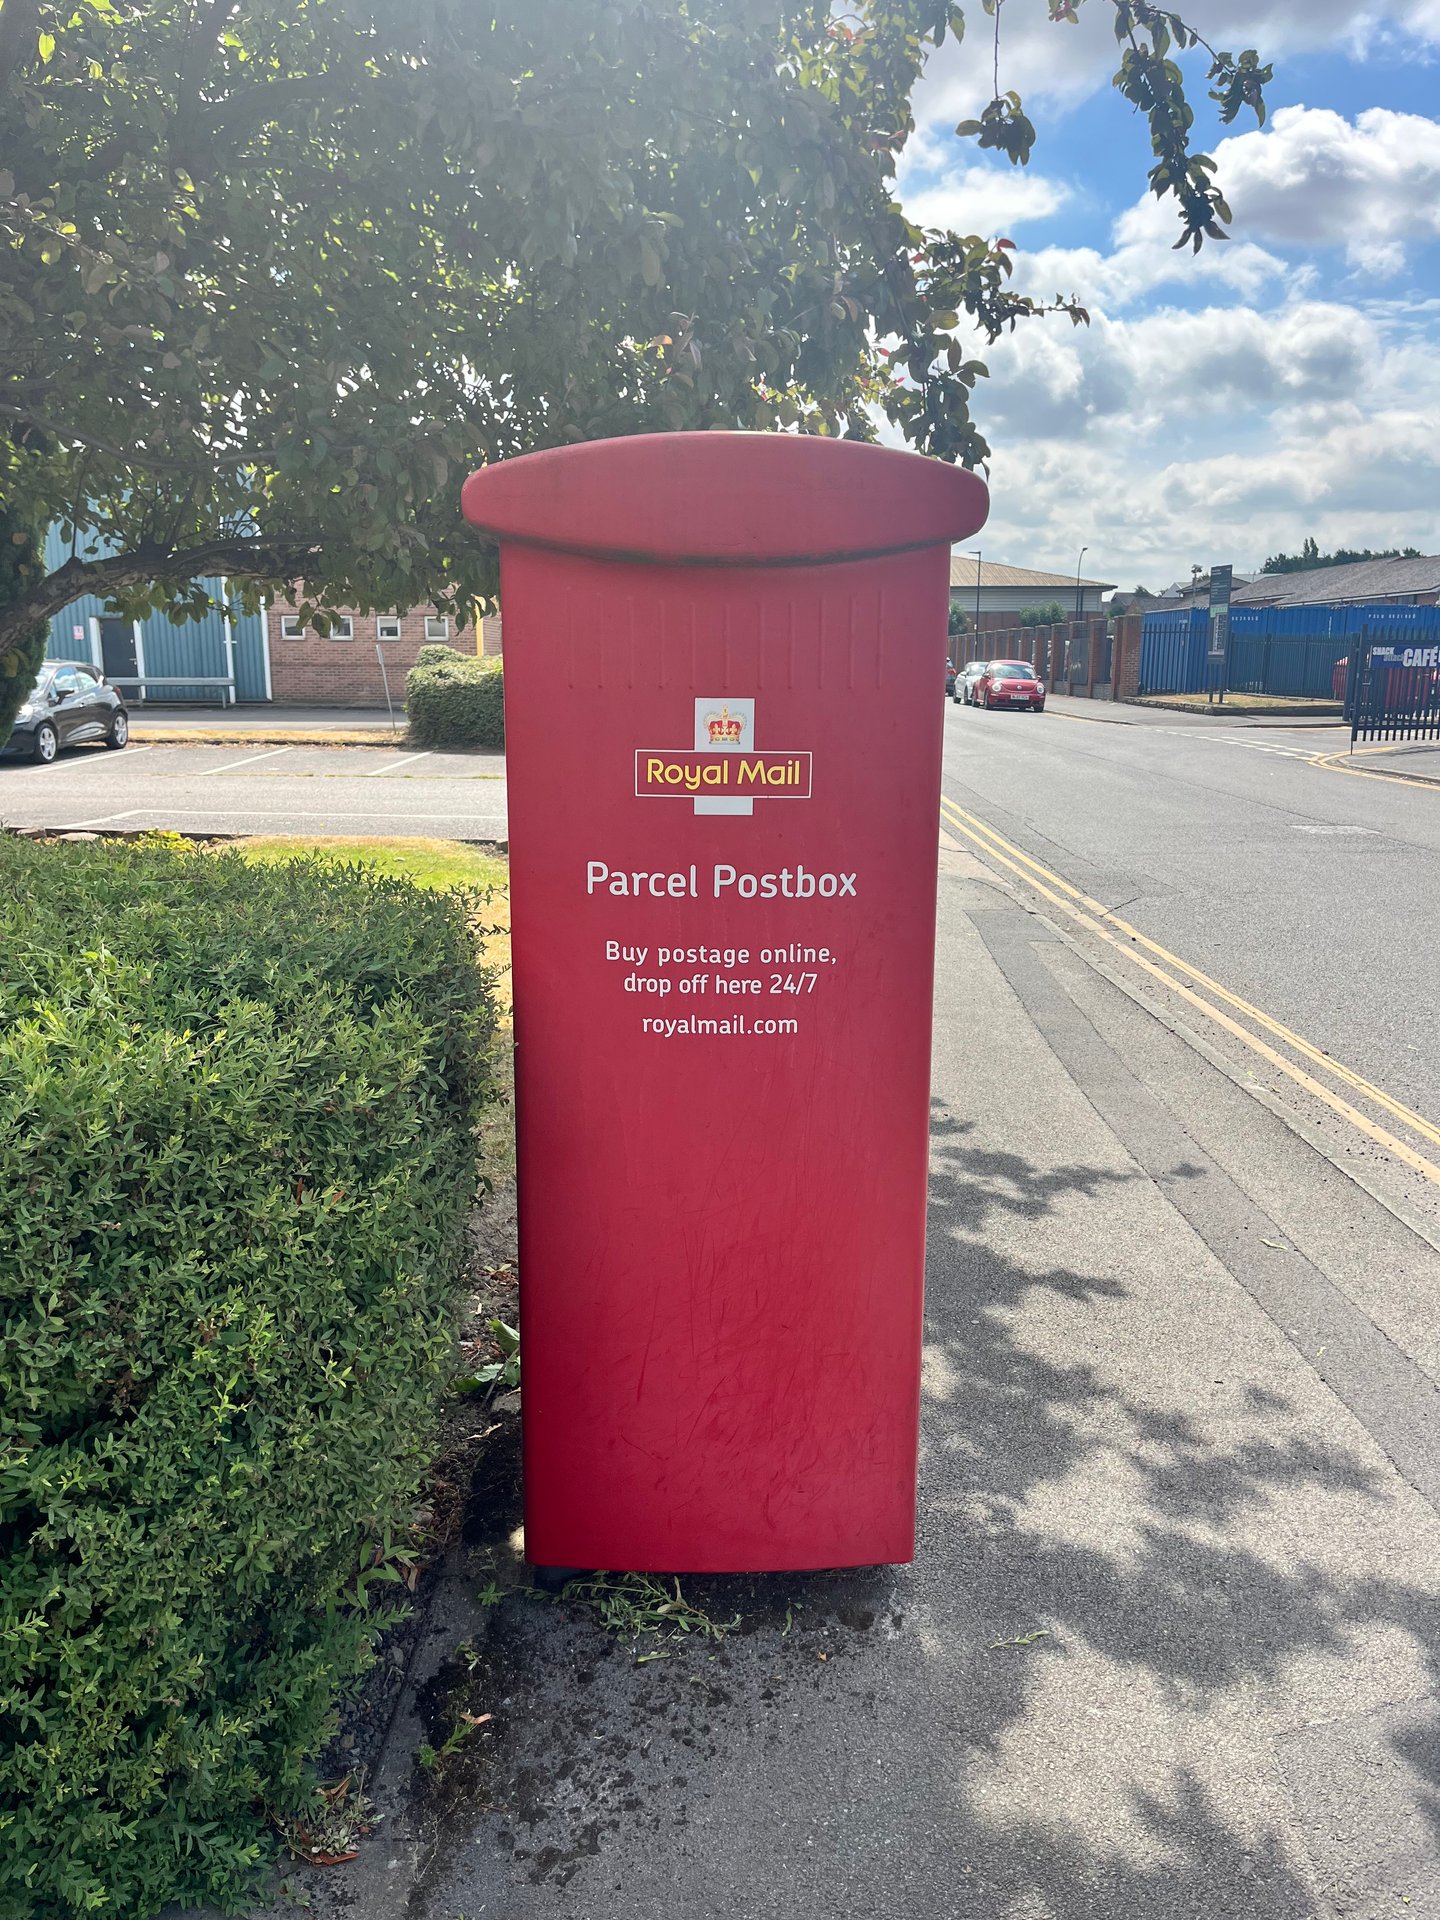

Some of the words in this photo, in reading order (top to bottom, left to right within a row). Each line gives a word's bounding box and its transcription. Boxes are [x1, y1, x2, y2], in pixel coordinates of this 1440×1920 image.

[646, 759, 729, 790] Royal
[737, 760, 801, 786] Mail
[586, 861, 699, 898] Parcel
[713, 864, 858, 899] Postbox
[605, 940, 649, 967] Buy
[657, 945, 750, 968] postage
[759, 943, 838, 965] online,
[623, 973, 672, 997] drop
[678, 974, 709, 994] off
[715, 975, 763, 994] here
[769, 972, 818, 995] 24/7
[642, 1014, 799, 1038] royalmail.com
